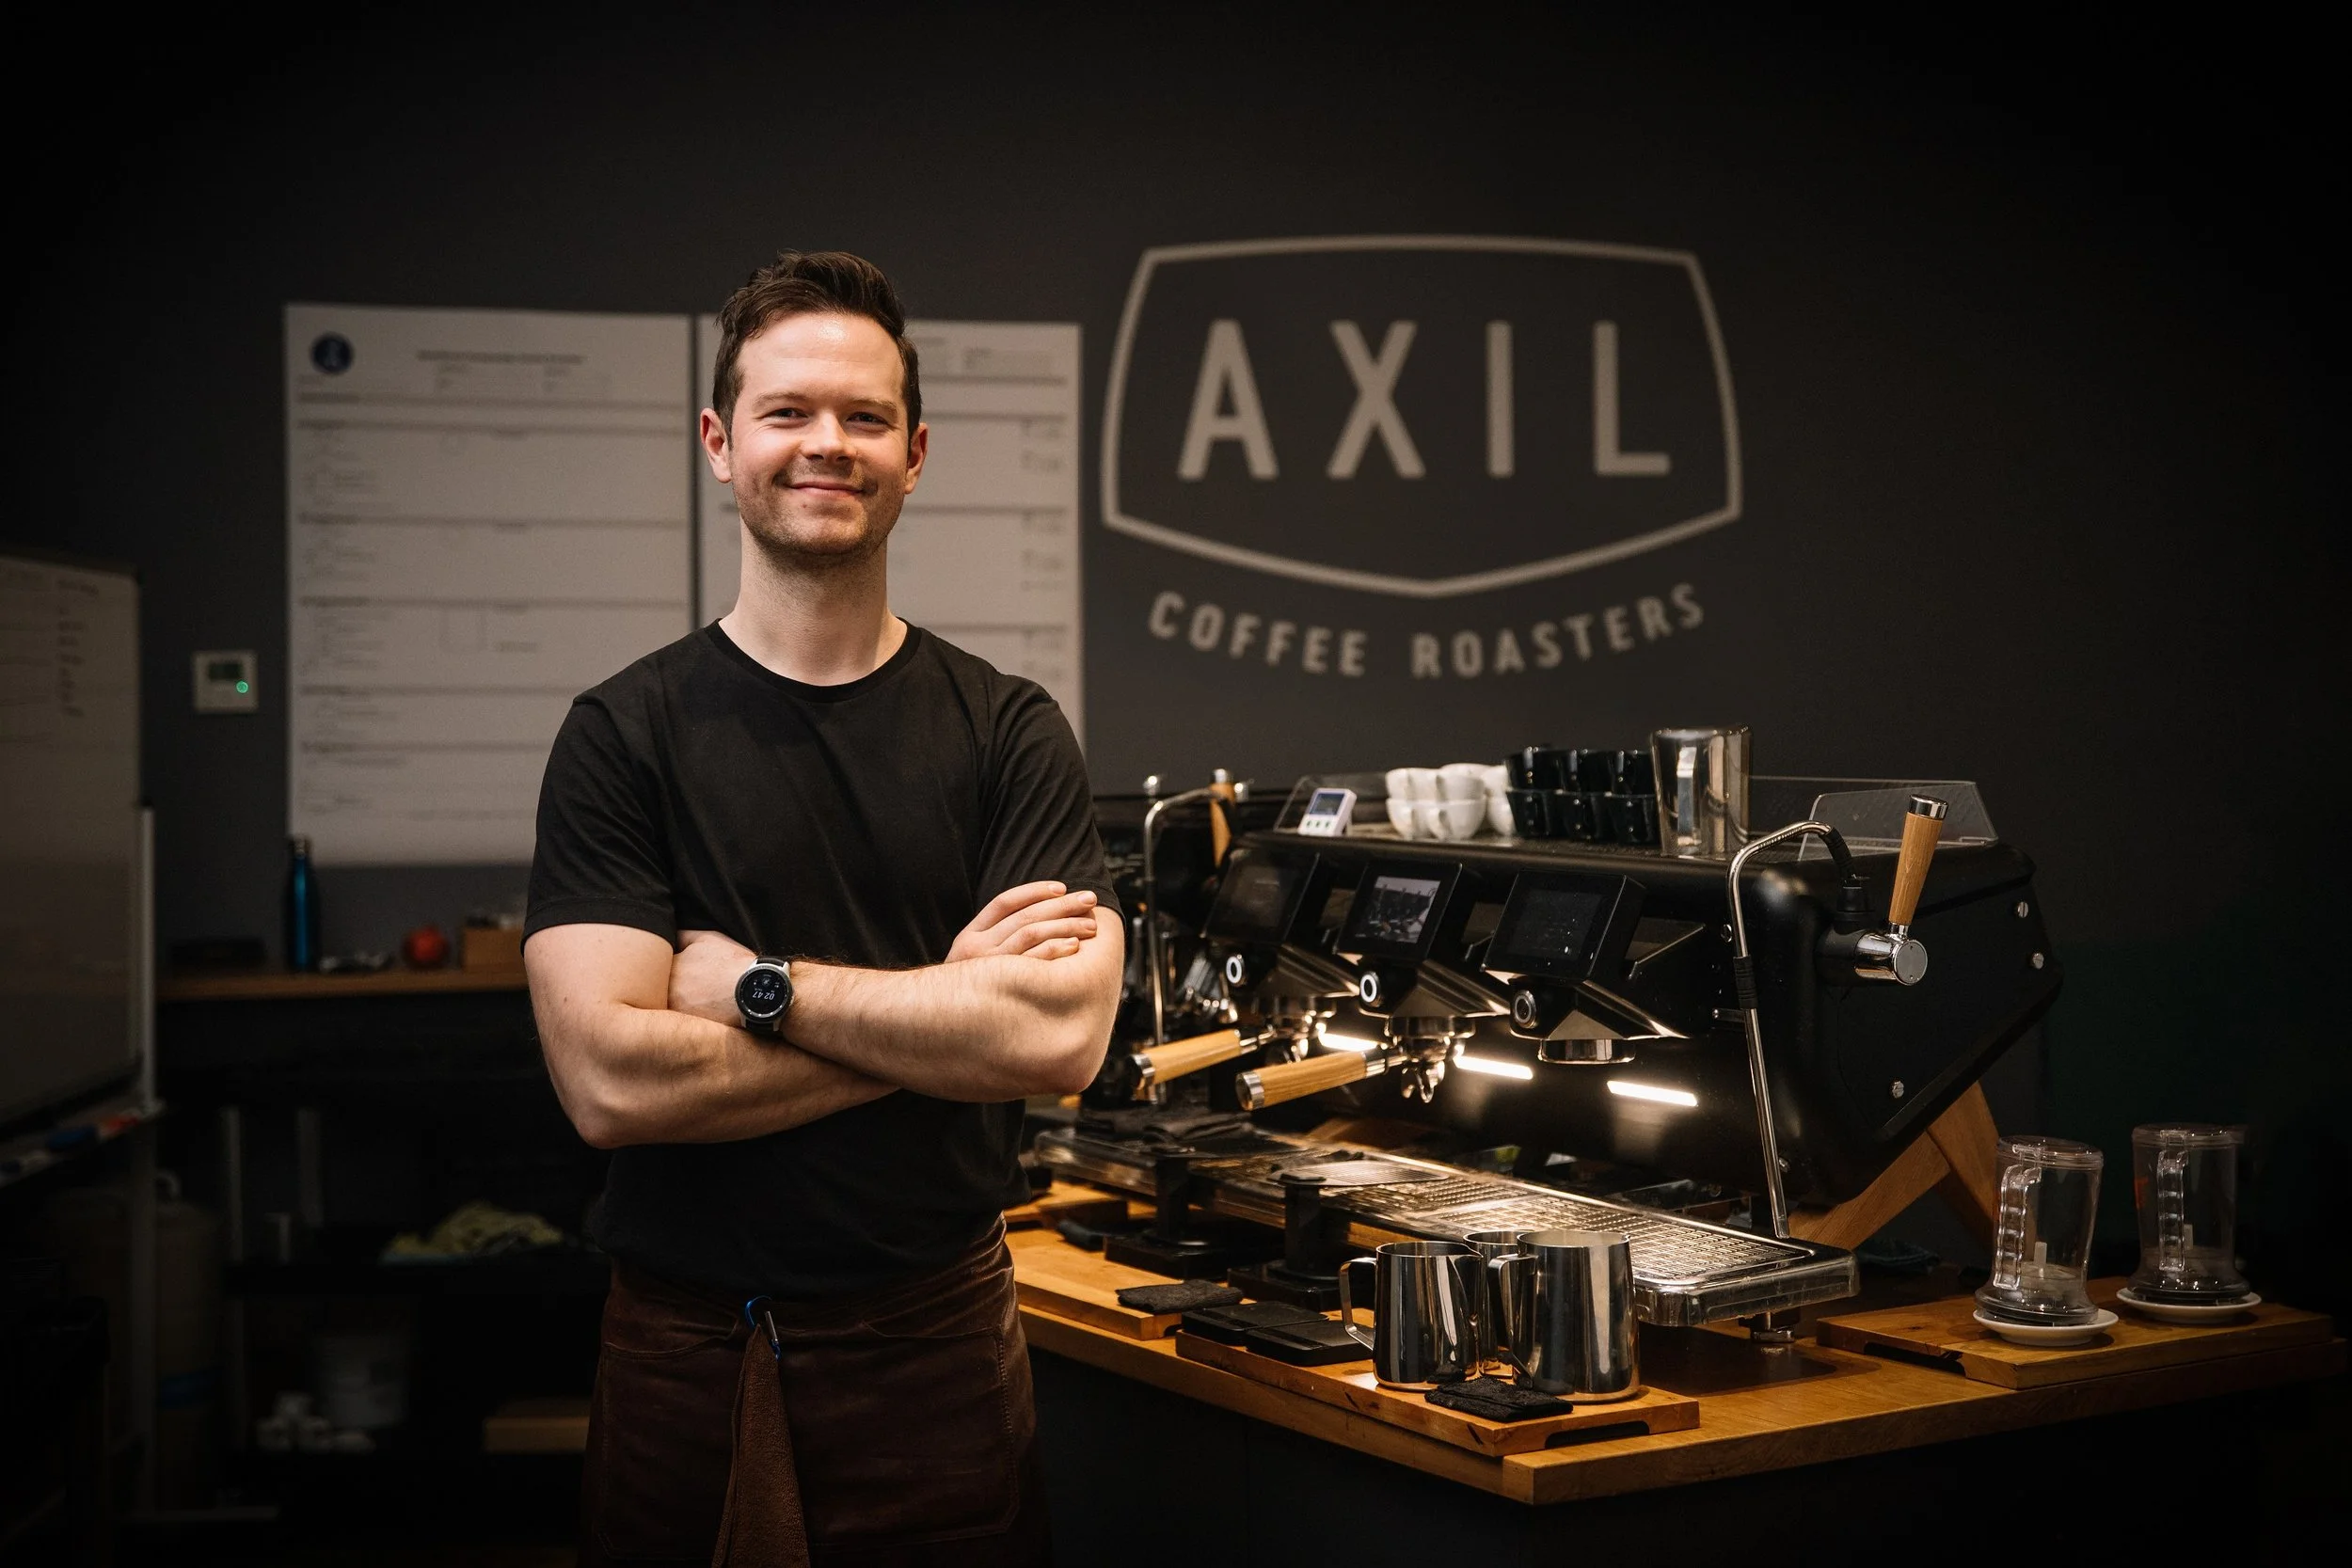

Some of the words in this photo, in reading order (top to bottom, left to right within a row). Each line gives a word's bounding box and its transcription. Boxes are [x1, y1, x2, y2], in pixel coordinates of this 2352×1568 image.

[1178, 319, 1672, 479] AXIL
[1149, 591, 1367, 677] COFFEE
[1411, 583, 1705, 678] ROASTERS
